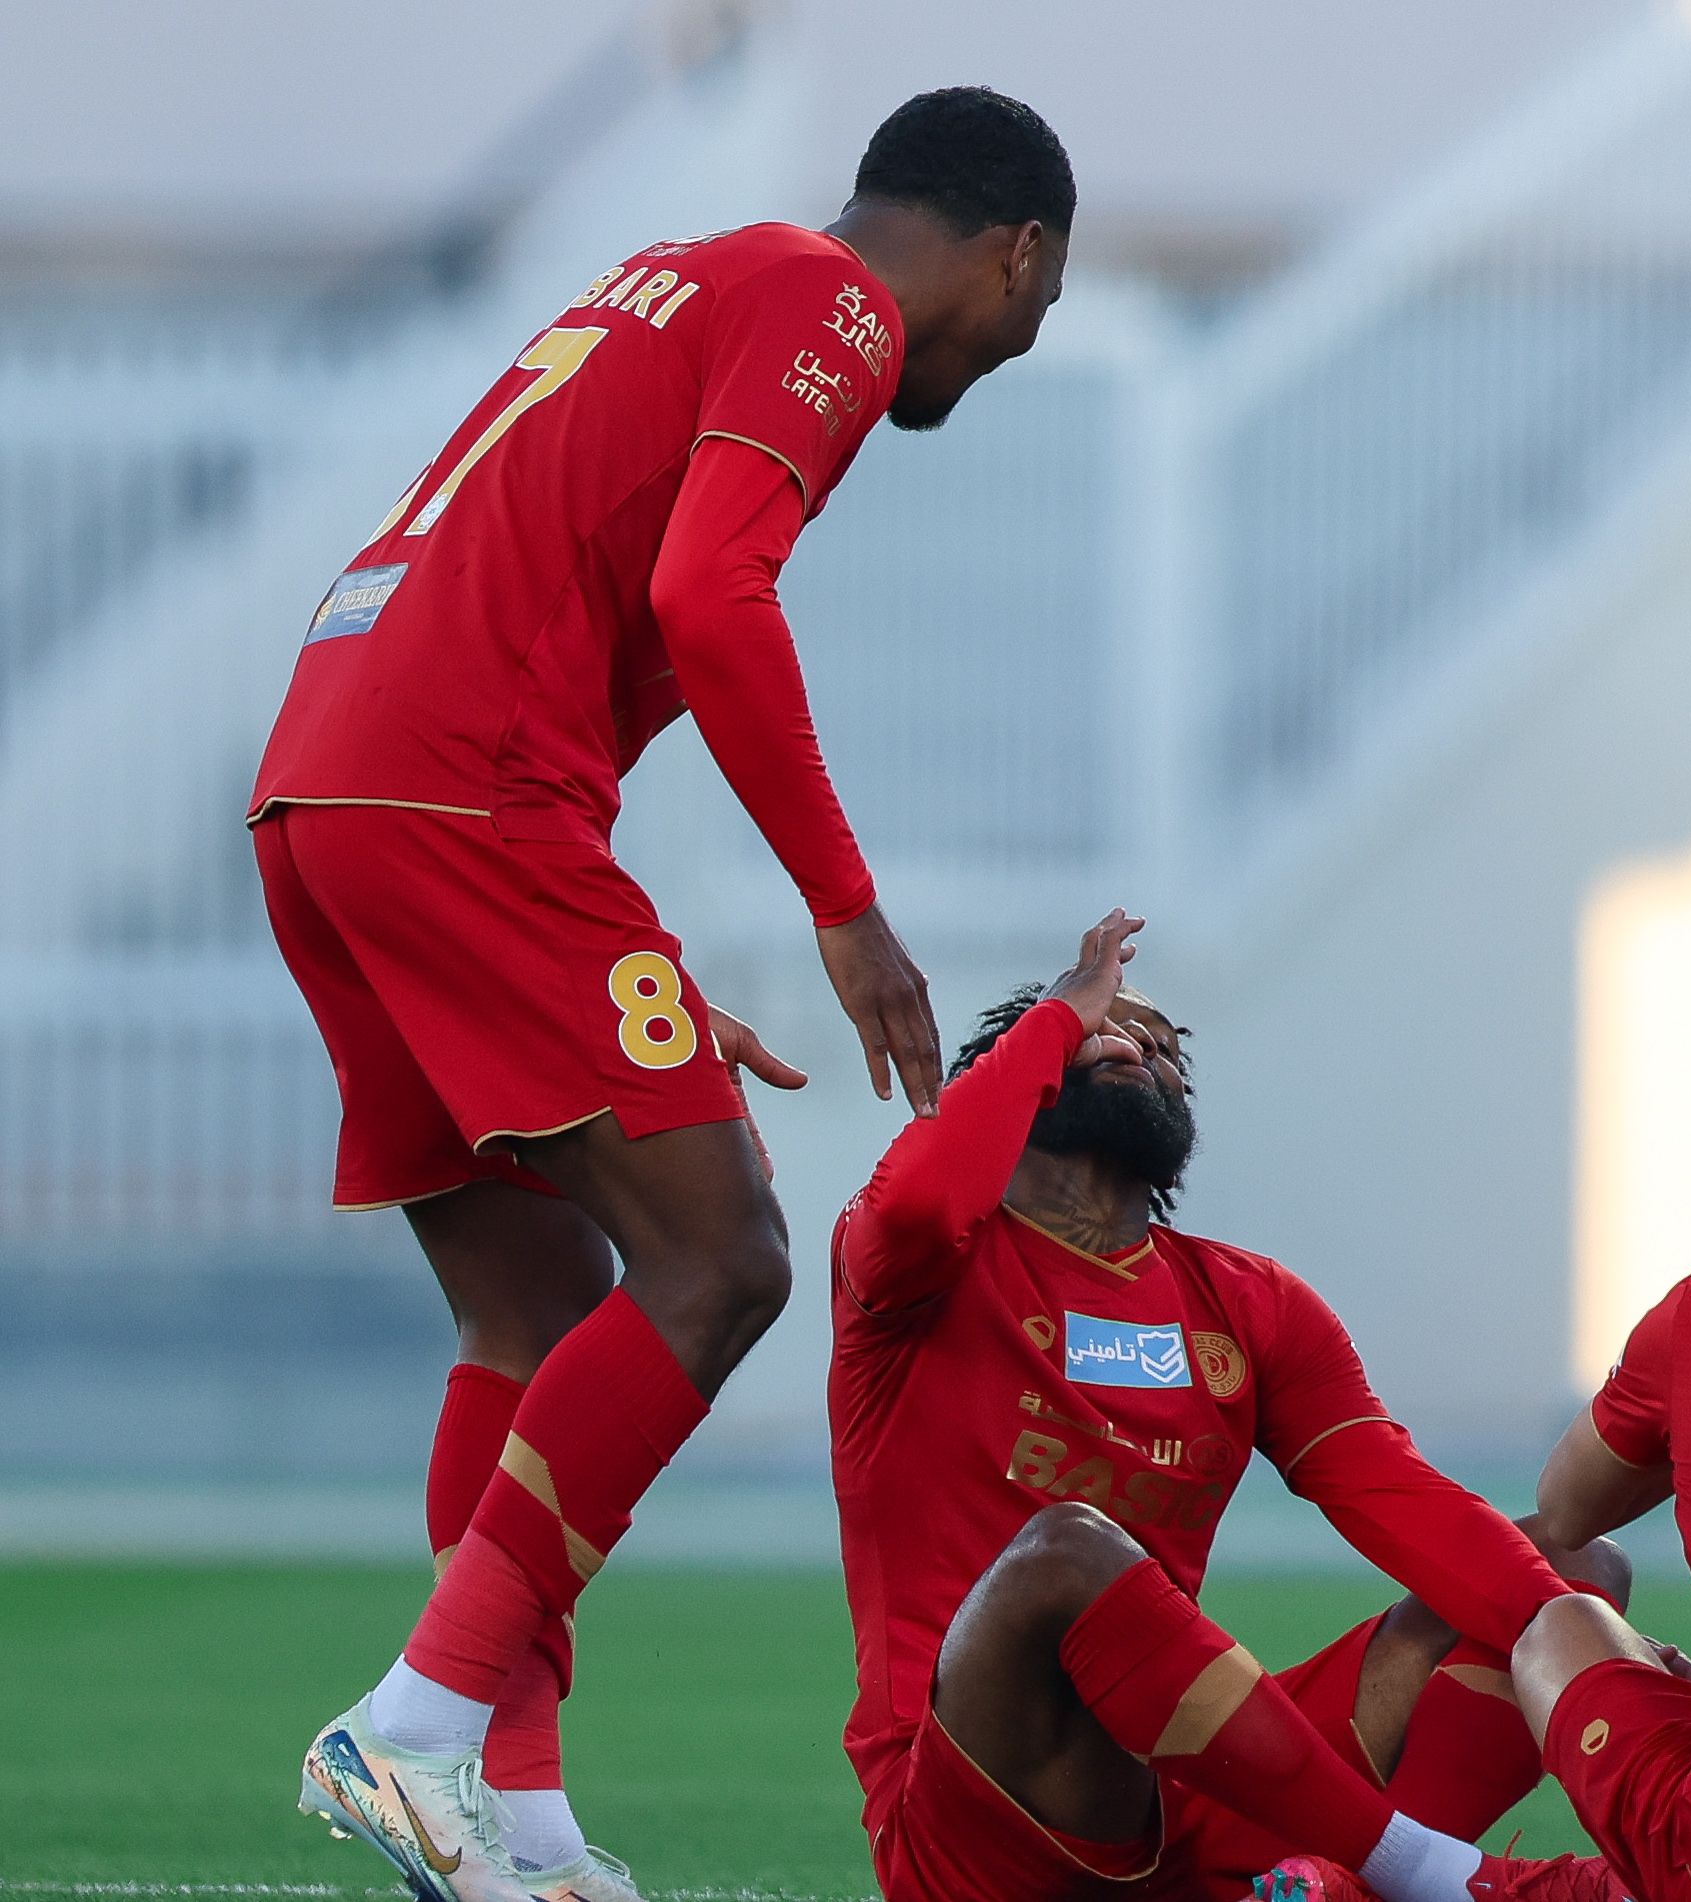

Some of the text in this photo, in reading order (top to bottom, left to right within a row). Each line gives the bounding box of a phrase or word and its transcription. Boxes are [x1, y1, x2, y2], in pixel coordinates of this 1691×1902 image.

[363, 326, 610, 549] 7
[608, 951, 697, 1070] 8
[1006, 1429, 1223, 1530] BASIC
